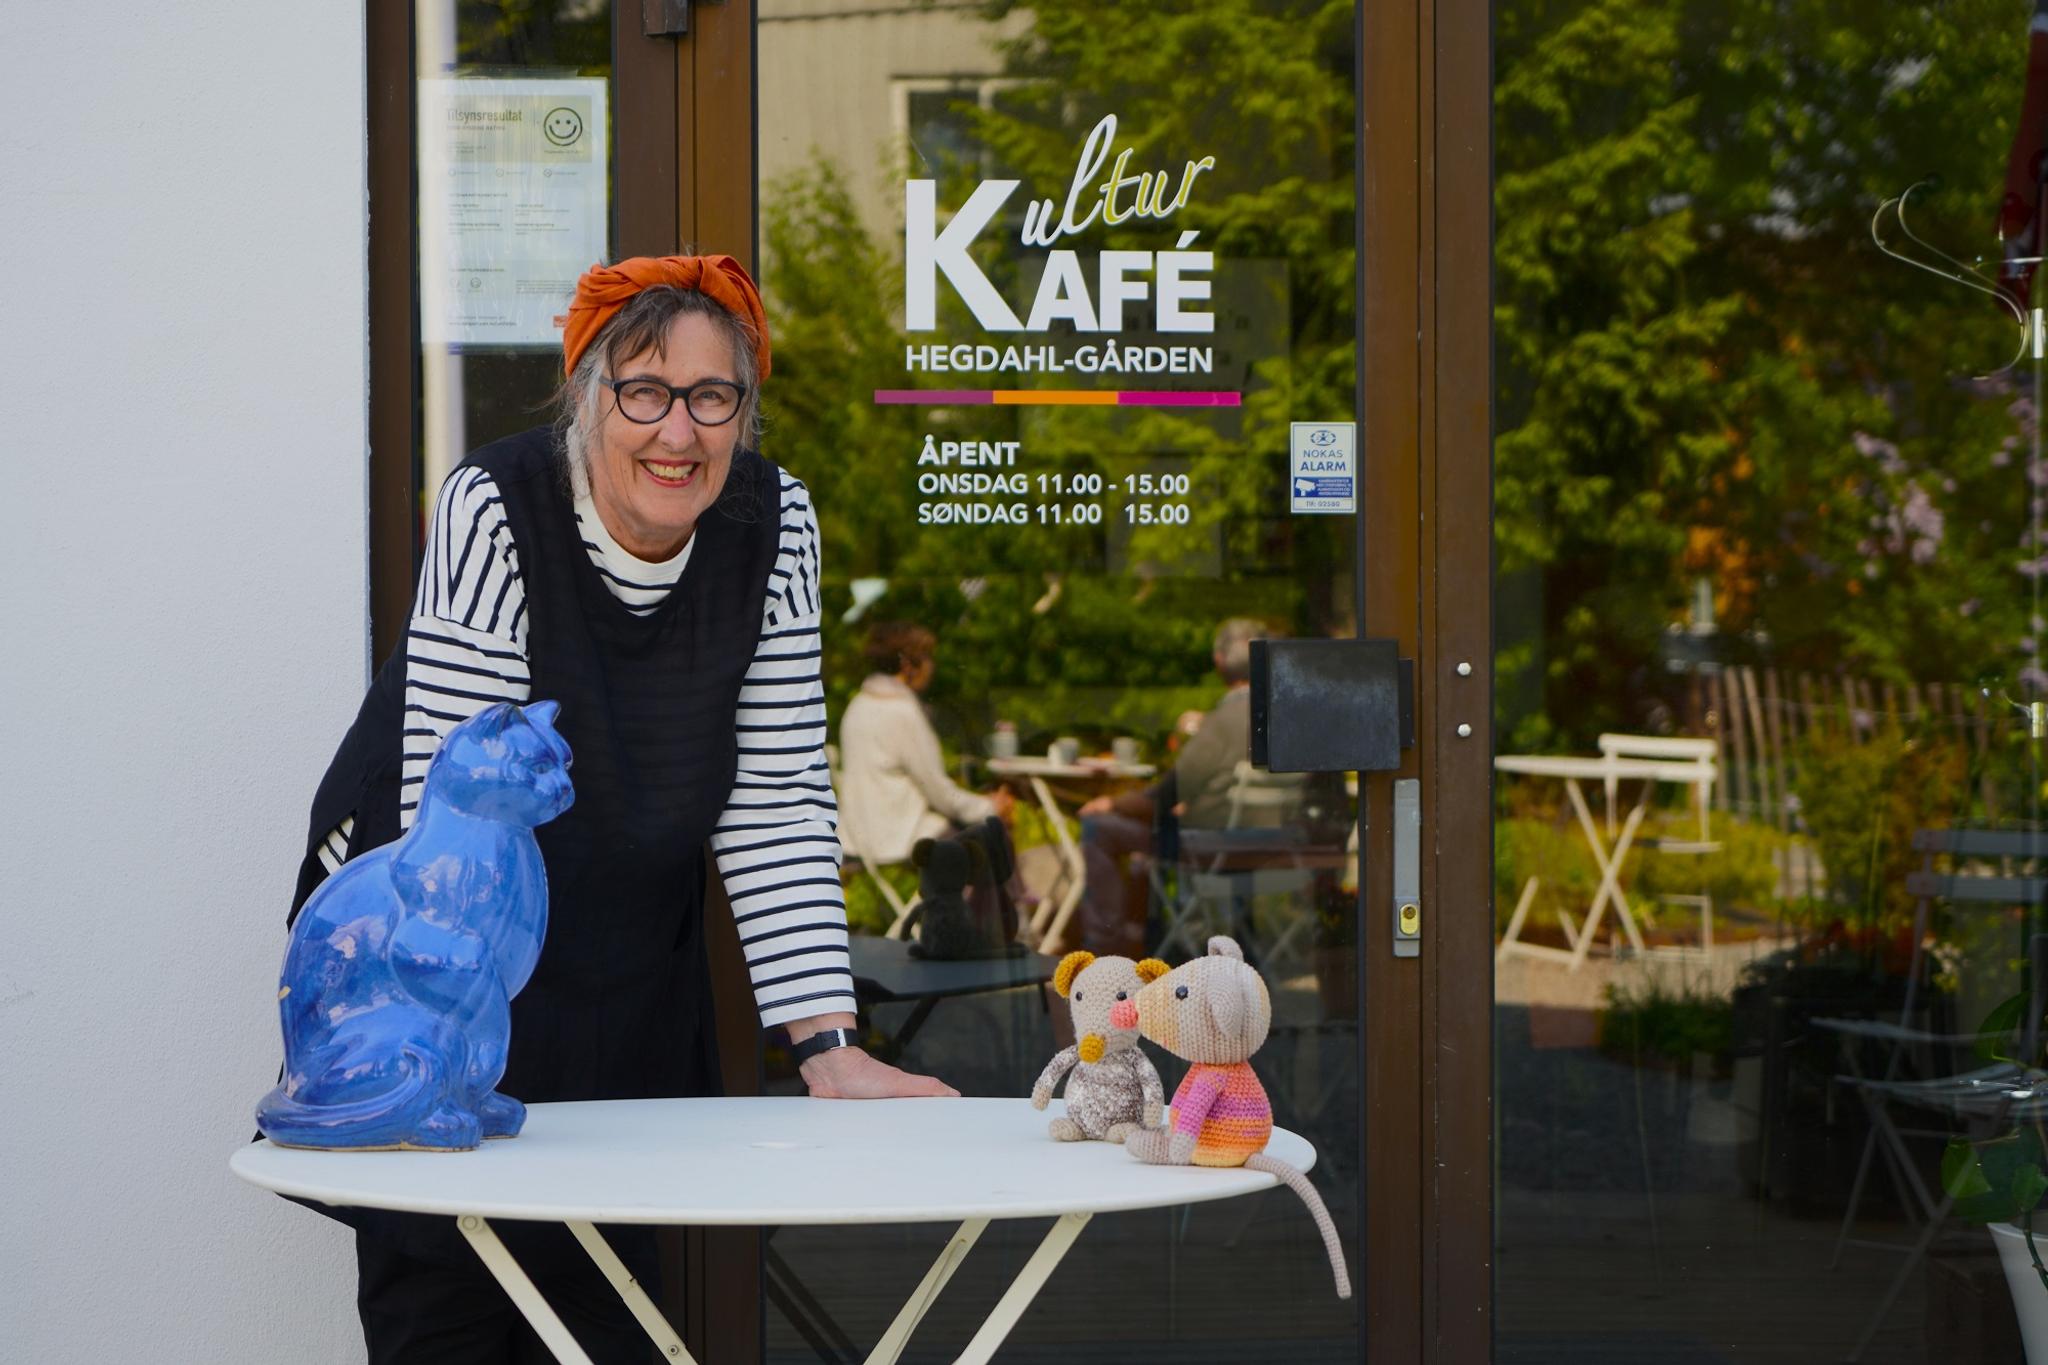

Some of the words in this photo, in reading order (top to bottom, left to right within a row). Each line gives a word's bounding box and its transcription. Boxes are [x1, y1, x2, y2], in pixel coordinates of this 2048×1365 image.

[905, 339, 1213, 373] HEGDAHL-GÅRDEN
[918, 434, 1020, 466] ÅPENT
[1303, 449, 1344, 458] NOKAS
[1300, 461, 1346, 471] ALARM
[918, 473, 1029, 494] ONSDAG
[1036, 473, 1102, 495] 11.00
[1124, 473, 1190, 495] 15.00
[918, 502, 1029, 524] SØNDAG
[1036, 503, 1102, 524] 11.00
[1124, 503, 1190, 525] 15.00
